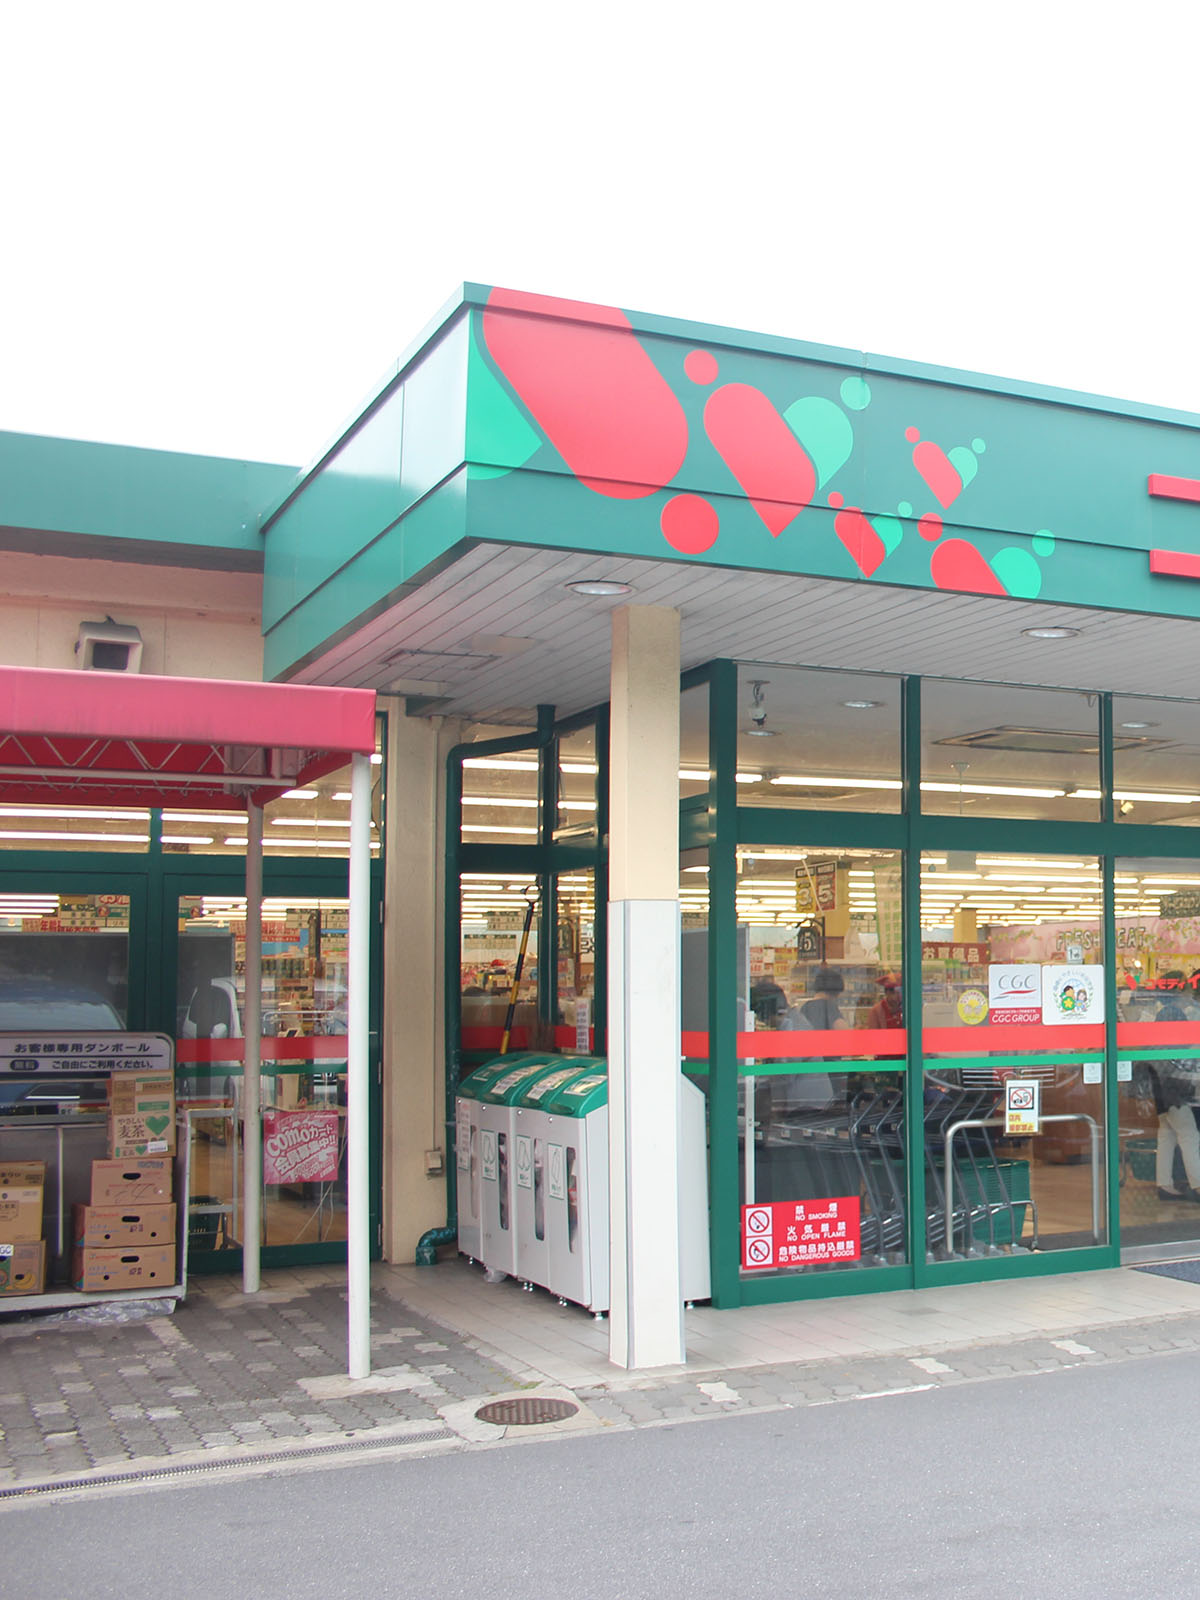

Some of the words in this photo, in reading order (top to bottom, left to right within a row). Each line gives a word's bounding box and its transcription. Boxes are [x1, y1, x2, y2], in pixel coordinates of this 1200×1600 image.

[998, 974, 1034, 989] CGC
[991, 1014, 1011, 1023] CGC
[1012, 1013, 1040, 1022] GROUP
[15, 1043, 150, 1054] お客様専用ダンボール
[808, 1212, 838, 1220] SMOKING
[824, 1231, 846, 1239] FLAME
[791, 1252, 830, 1261] DANGEROUS
[833, 1249, 855, 1258] GOODS
